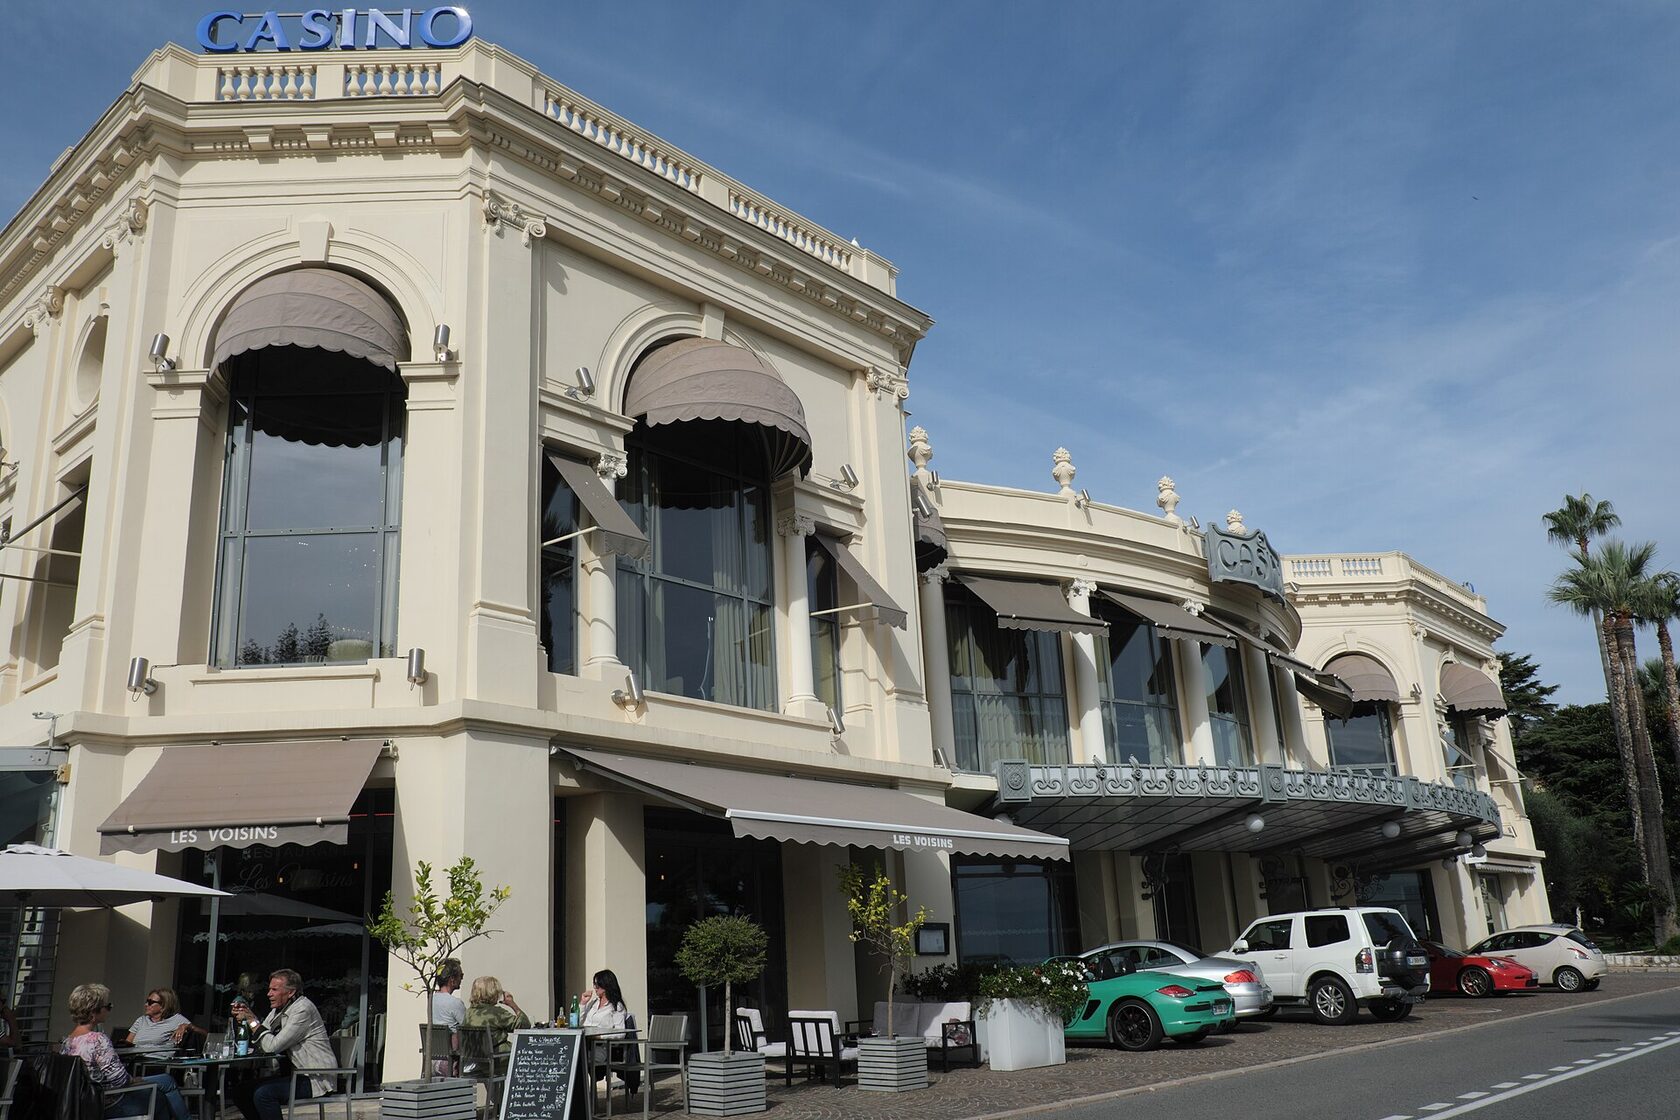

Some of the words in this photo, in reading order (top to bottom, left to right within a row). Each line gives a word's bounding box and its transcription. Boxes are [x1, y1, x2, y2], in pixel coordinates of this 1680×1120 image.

[195, 6, 474, 52] CASINO
[171, 829, 198, 844] LES
[208, 826, 278, 843] VOISINS
[893, 834, 911, 845] LES
[914, 836, 953, 848] VOISINS
[230, 863, 272, 900] Les
